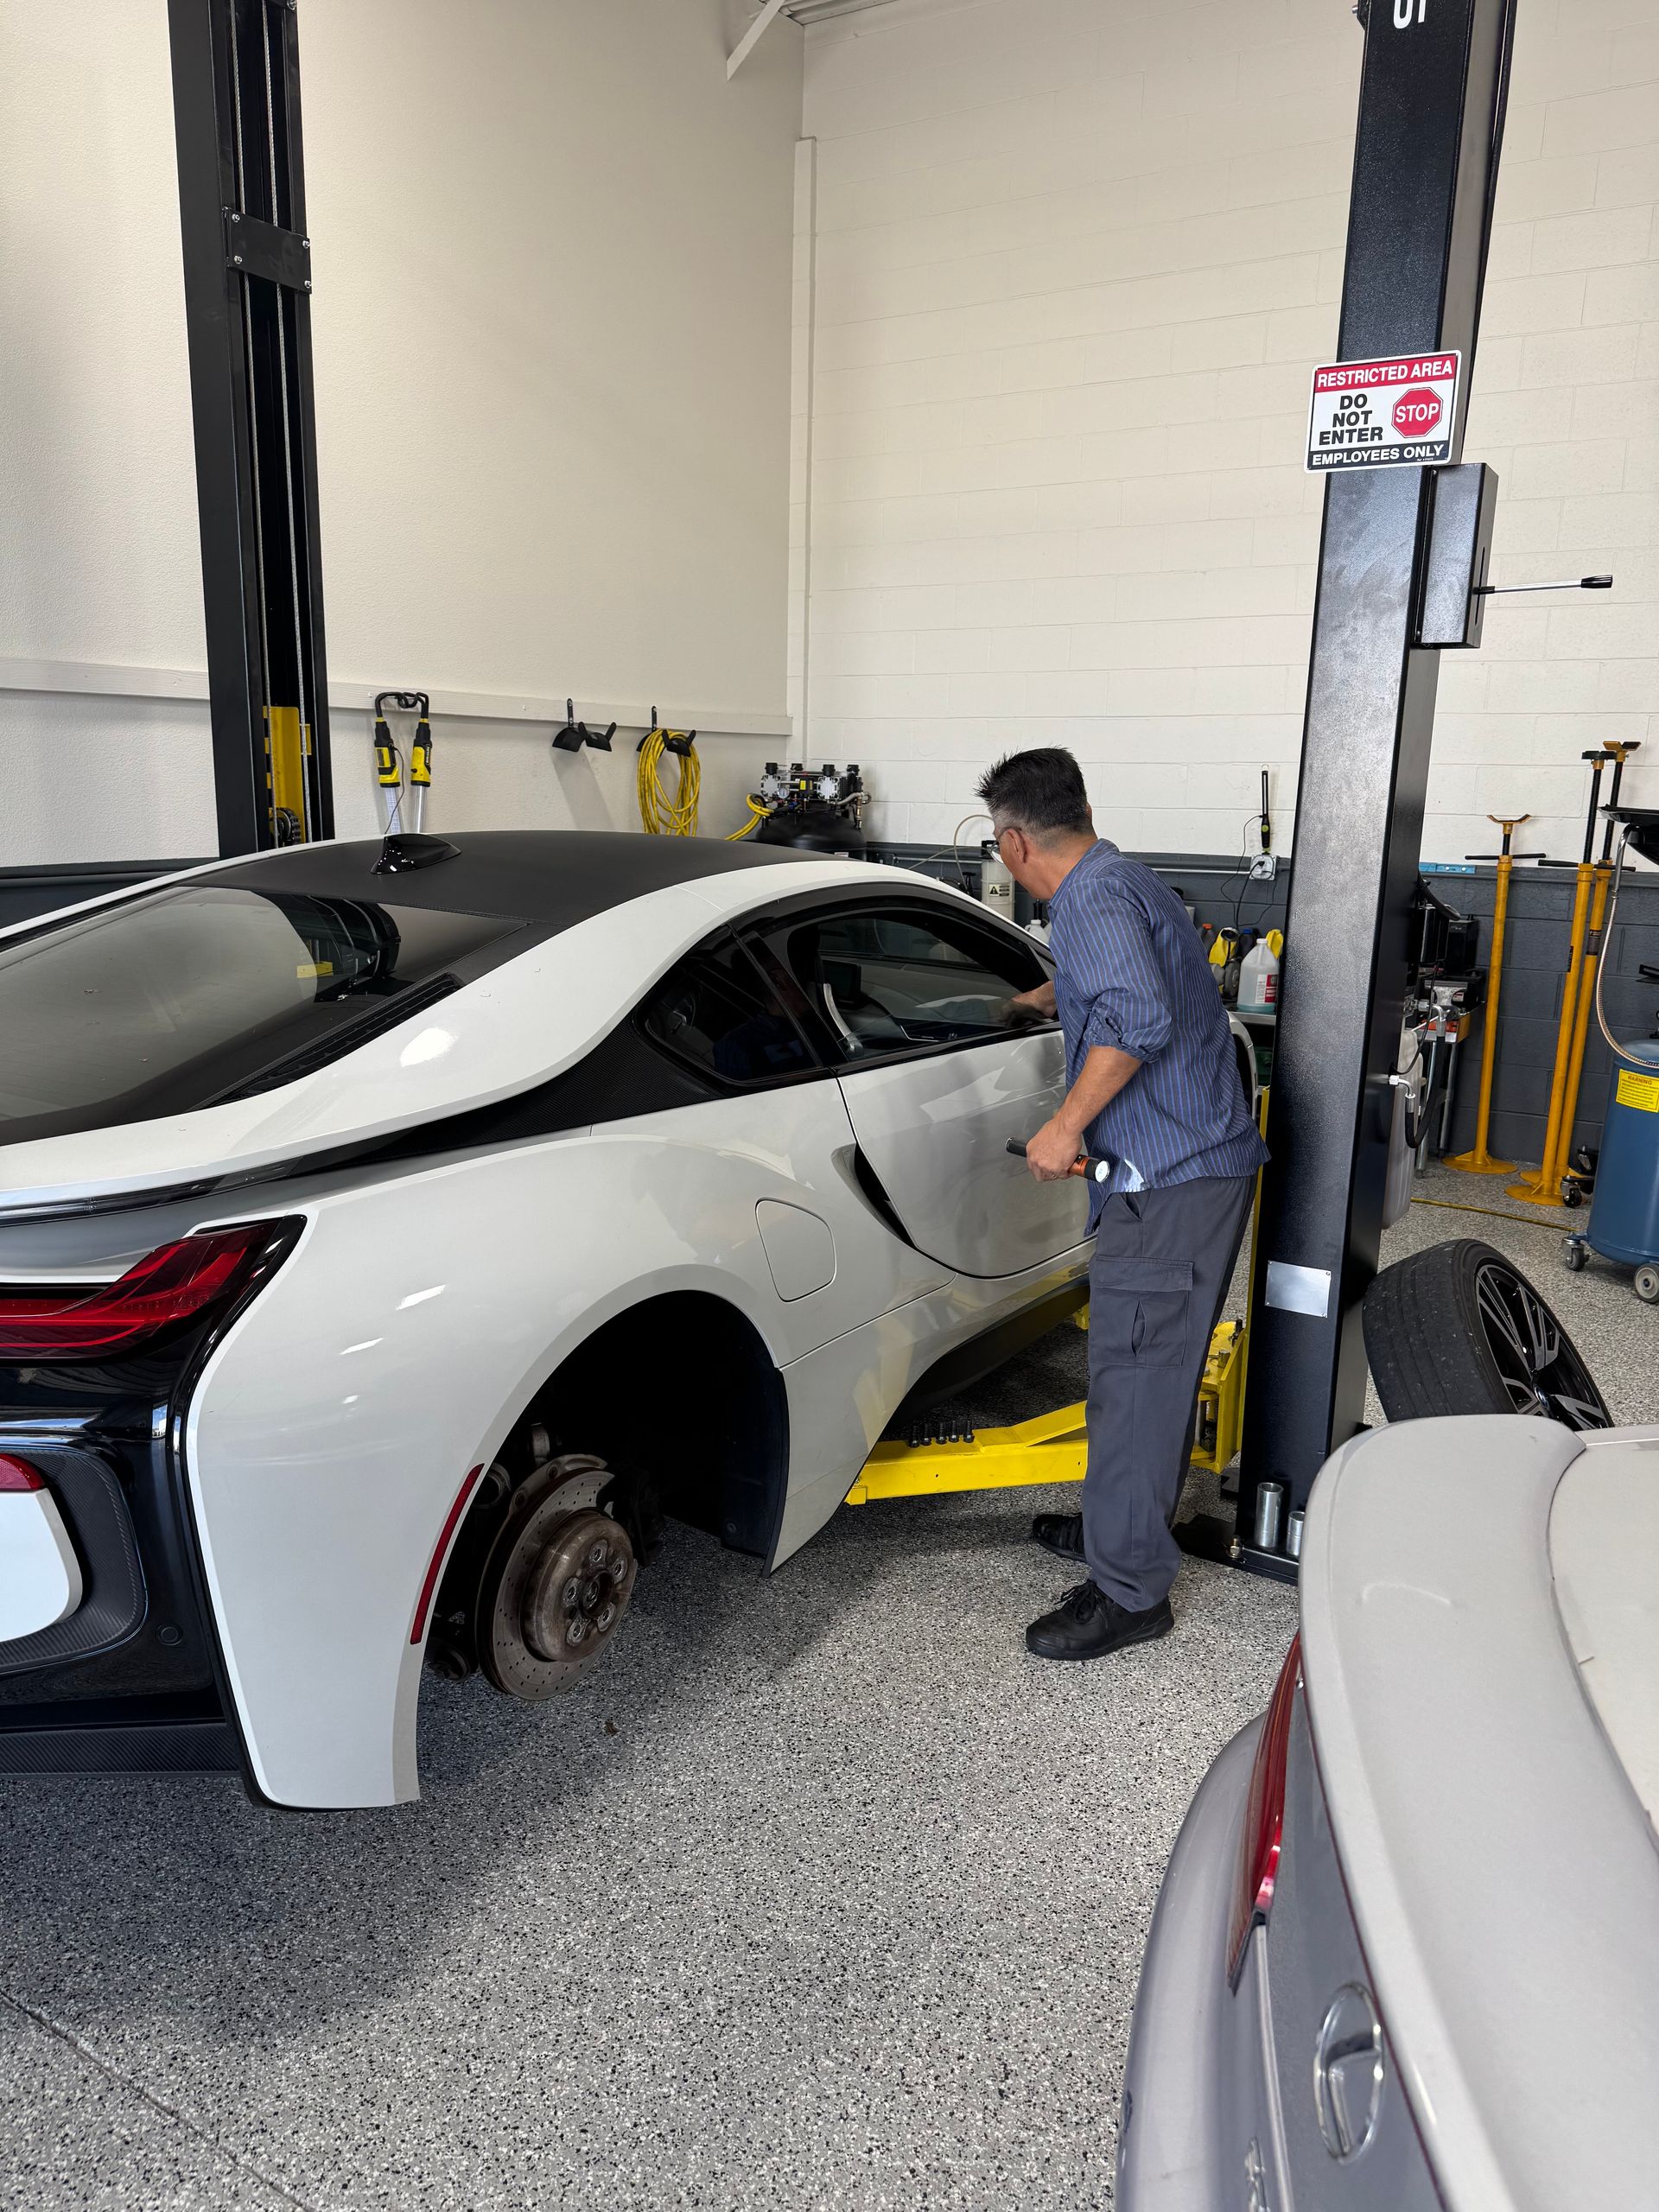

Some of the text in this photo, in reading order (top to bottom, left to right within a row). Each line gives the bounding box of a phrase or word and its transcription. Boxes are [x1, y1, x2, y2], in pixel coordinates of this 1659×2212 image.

[1317, 359, 1452, 388] RESTRICTED AREA
[1339, 393, 1368, 410] DO
[1332, 410, 1373, 428] NOT
[1395, 403, 1440, 423] STOP
[1319, 426, 1383, 446] ENTER
[1312, 443, 1445, 466] EMPLOYEES ONLY
[1627, 1075, 1653, 1085] WARNING
